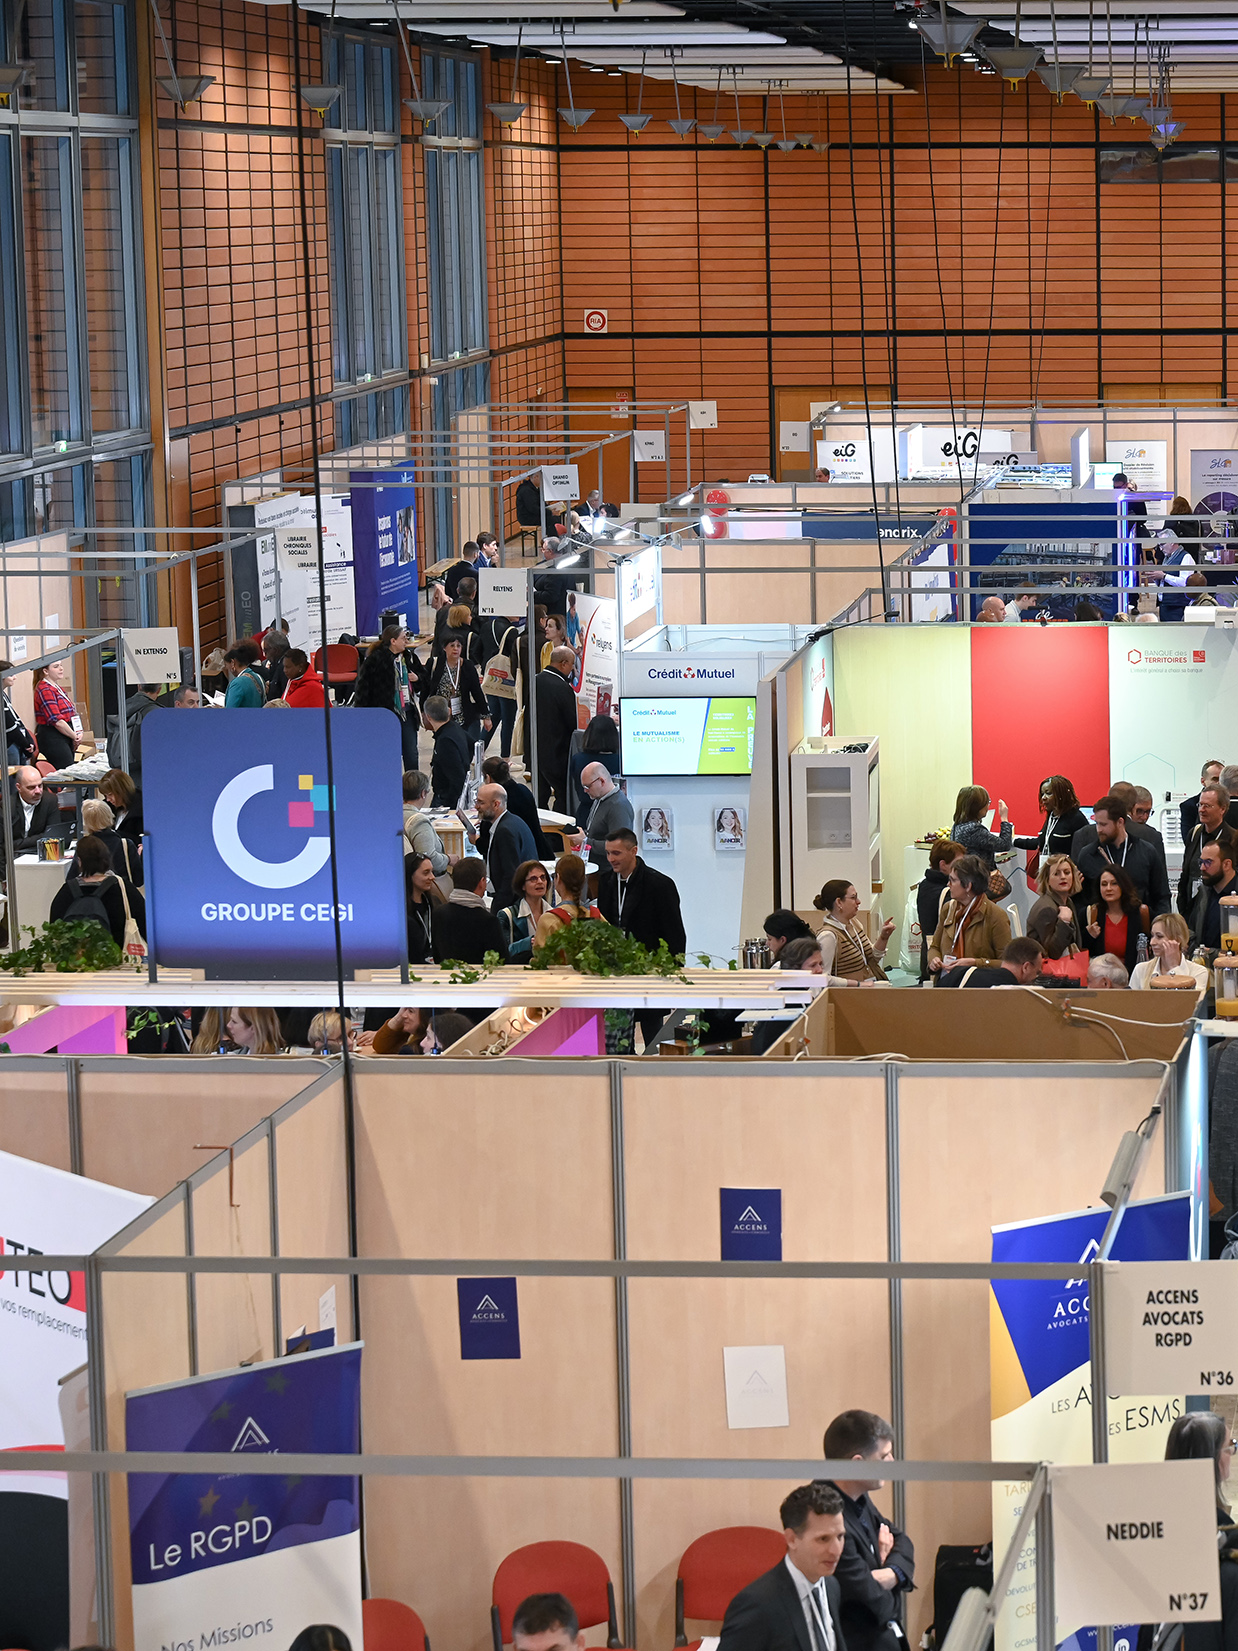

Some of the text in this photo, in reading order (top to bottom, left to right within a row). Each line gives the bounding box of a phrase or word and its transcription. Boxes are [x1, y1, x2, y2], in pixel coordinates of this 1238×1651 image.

[135, 647, 168, 656] IN EXTENSO
[648, 667, 736, 679] Crédit Mutuel
[201, 903, 354, 921] GROUPE CEGI
[1146, 1289, 1200, 1305] ACCENS
[1, 1297, 18, 1314] vos
[1047, 1315, 1089, 1330] AVOCATS
[1142, 1311, 1205, 1326] AVOCATS
[1155, 1332, 1193, 1347] RGPD
[1200, 1371, 1235, 1386] N°36
[1051, 1398, 1070, 1414] LES
[1108, 1397, 1181, 1436] ES ESMS
[1106, 1521, 1165, 1541] NEDDIE
[150, 1515, 273, 1571] Le RGPD
[1168, 1593, 1209, 1612] N°37
[199, 1618, 274, 1651] Missions
